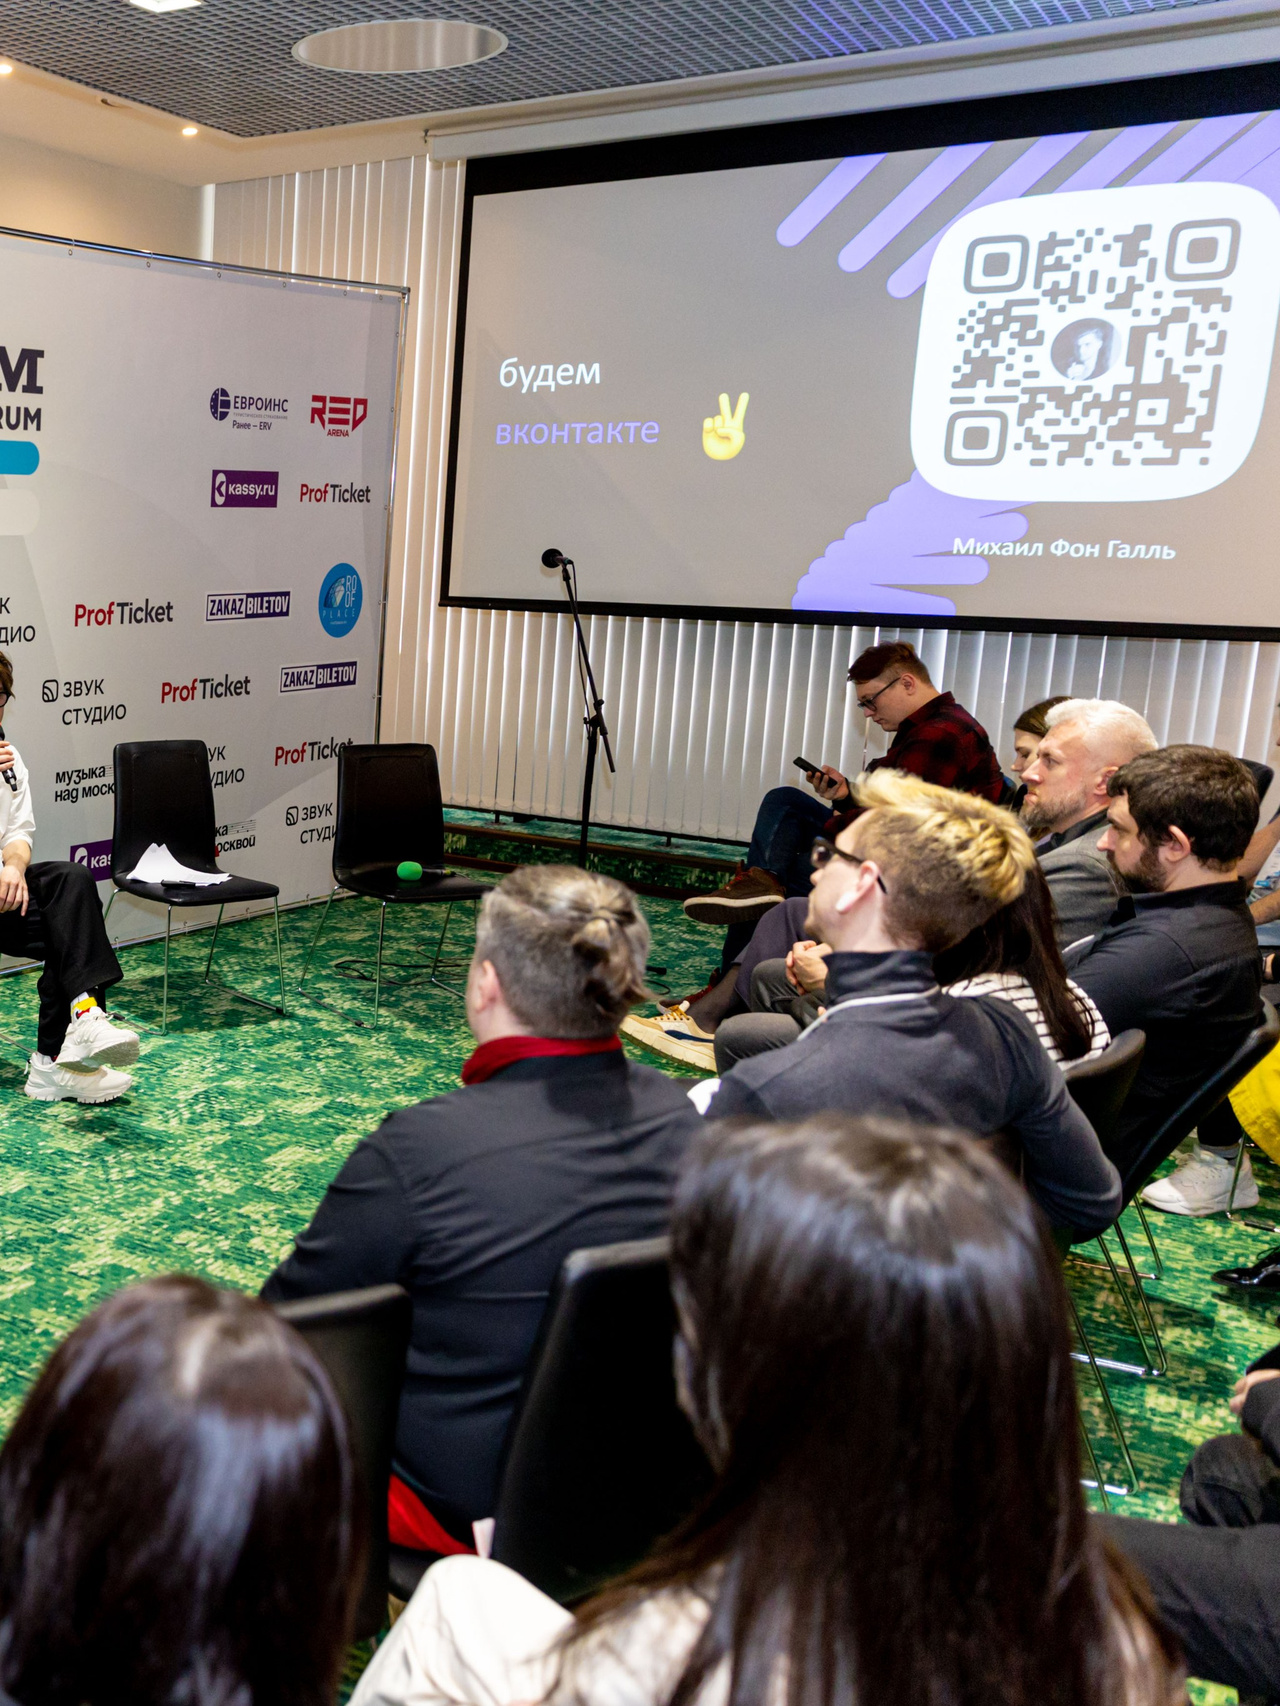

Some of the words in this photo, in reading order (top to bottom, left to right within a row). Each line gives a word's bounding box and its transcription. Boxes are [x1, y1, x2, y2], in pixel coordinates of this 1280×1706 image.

[499, 357, 601, 394] будем
[233, 395, 289, 413] ЕВРОИНС
[310, 394, 368, 432] RED
[326, 429, 350, 438] ARENA
[495, 419, 661, 445] вконтакте
[228, 481, 276, 499] kassy.ru
[952, 537, 1044, 557] Михаил
[1049, 538, 1101, 558] Фон
[1106, 540, 1177, 560] Галль
[209, 598, 244, 617] ZAKAZ
[246, 595, 289, 615] BILETOV
[282, 668, 315, 688] ZAKAZ
[316, 664, 356, 685] BILETOV
[63, 679, 105, 698] ЗВУК
[61, 704, 127, 726] СТУДИО
[208, 745, 226, 762] УК
[55, 765, 106, 787] музыка
[54, 787, 80, 804] над
[82, 782, 115, 799] моск
[301, 802, 333, 821] ЗВУК
[216, 834, 256, 854] осквой
[300, 824, 336, 844] СТУДИ
